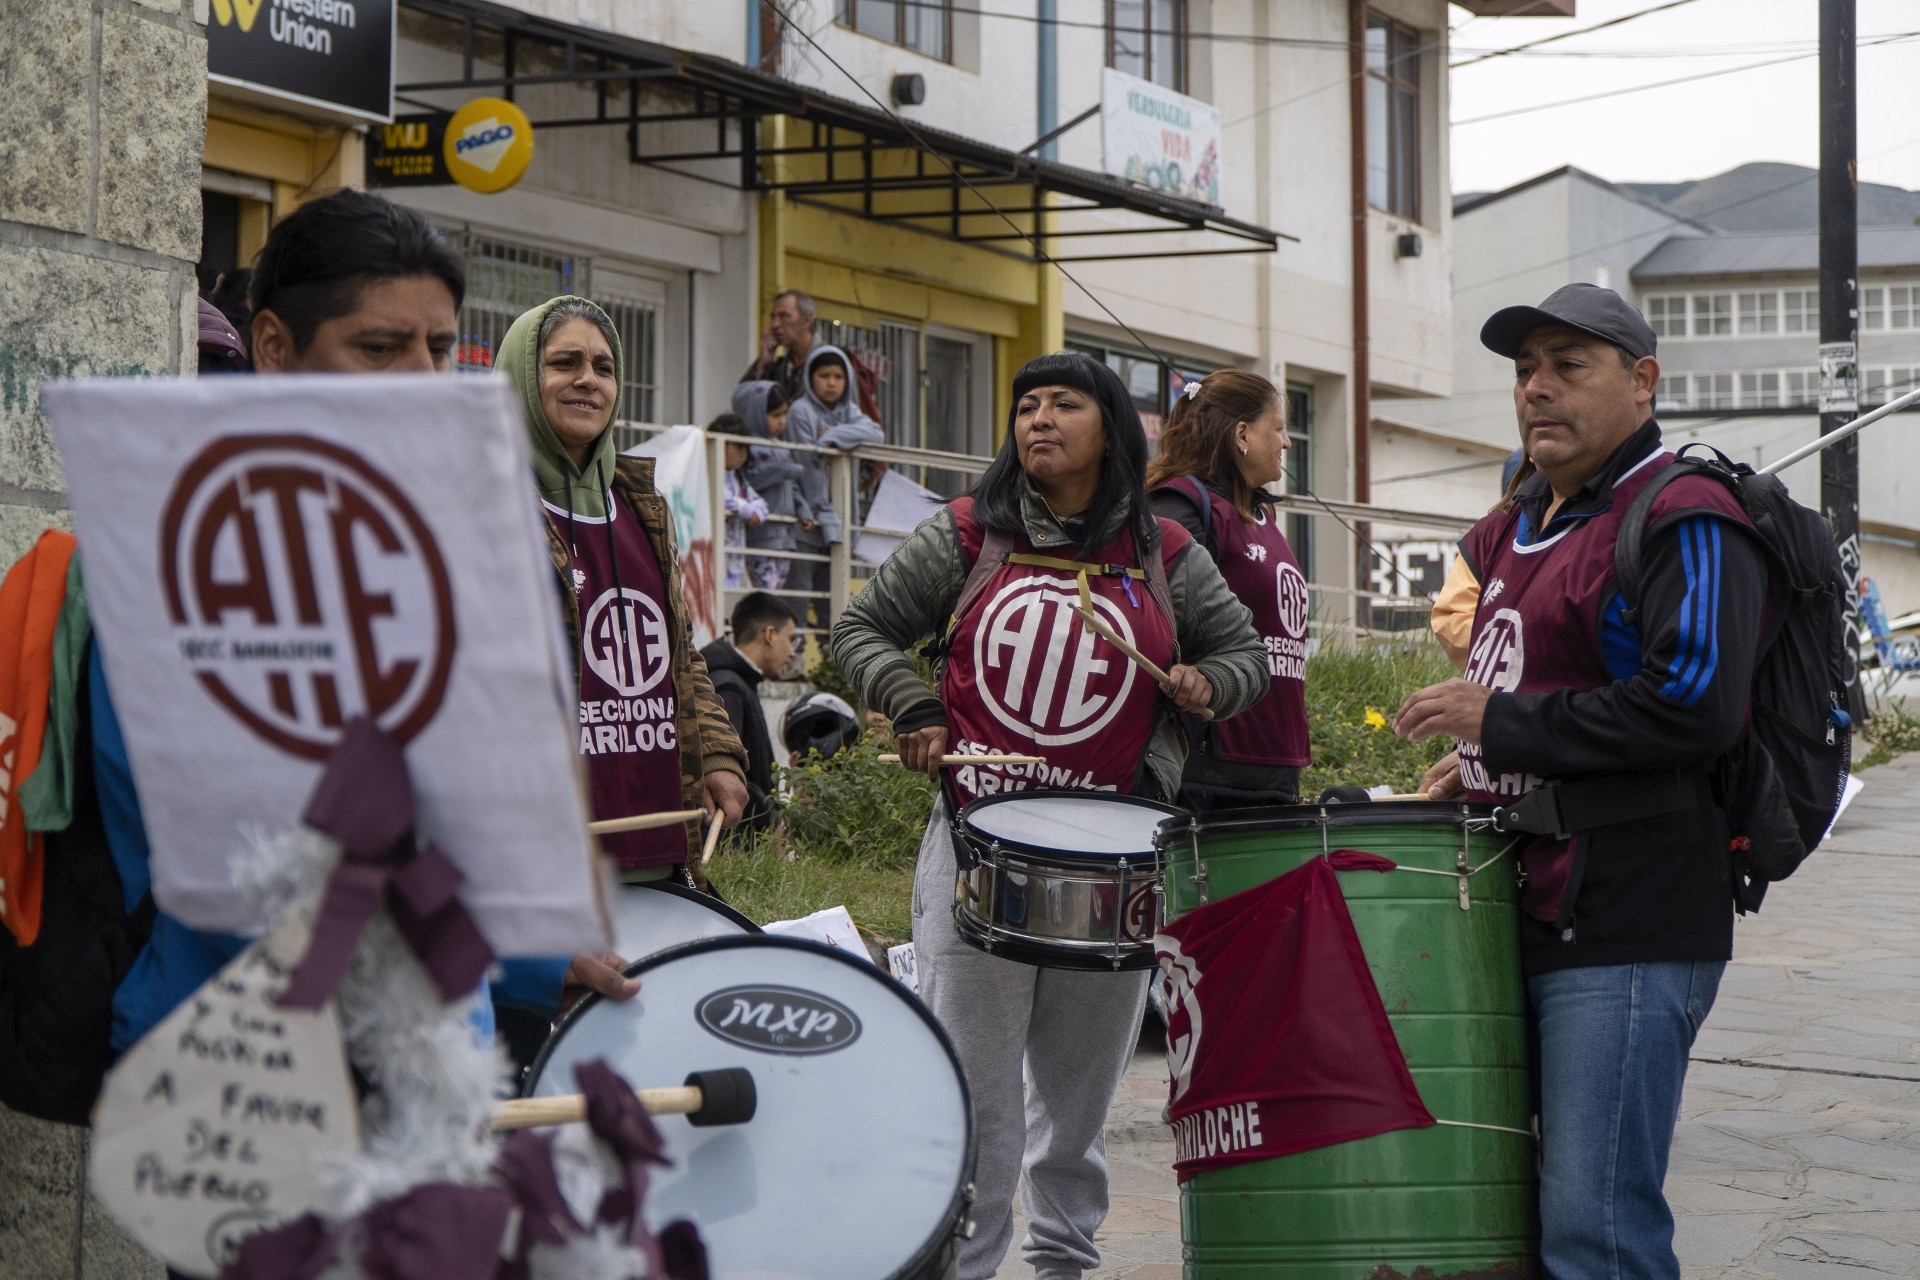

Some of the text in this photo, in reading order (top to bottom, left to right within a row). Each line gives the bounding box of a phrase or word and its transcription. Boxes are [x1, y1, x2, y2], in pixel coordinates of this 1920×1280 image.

[269, 7, 332, 55] Union
[271, 0, 356, 29] estern
[455, 124, 513, 154] PAGO
[392, 165, 434, 176] UNION
[190, 462, 425, 732] ATE
[1279, 566, 1308, 634] ATE
[587, 593, 667, 693] ATE
[983, 585, 1122, 732] ATE
[719, 998, 838, 1039] MXP
